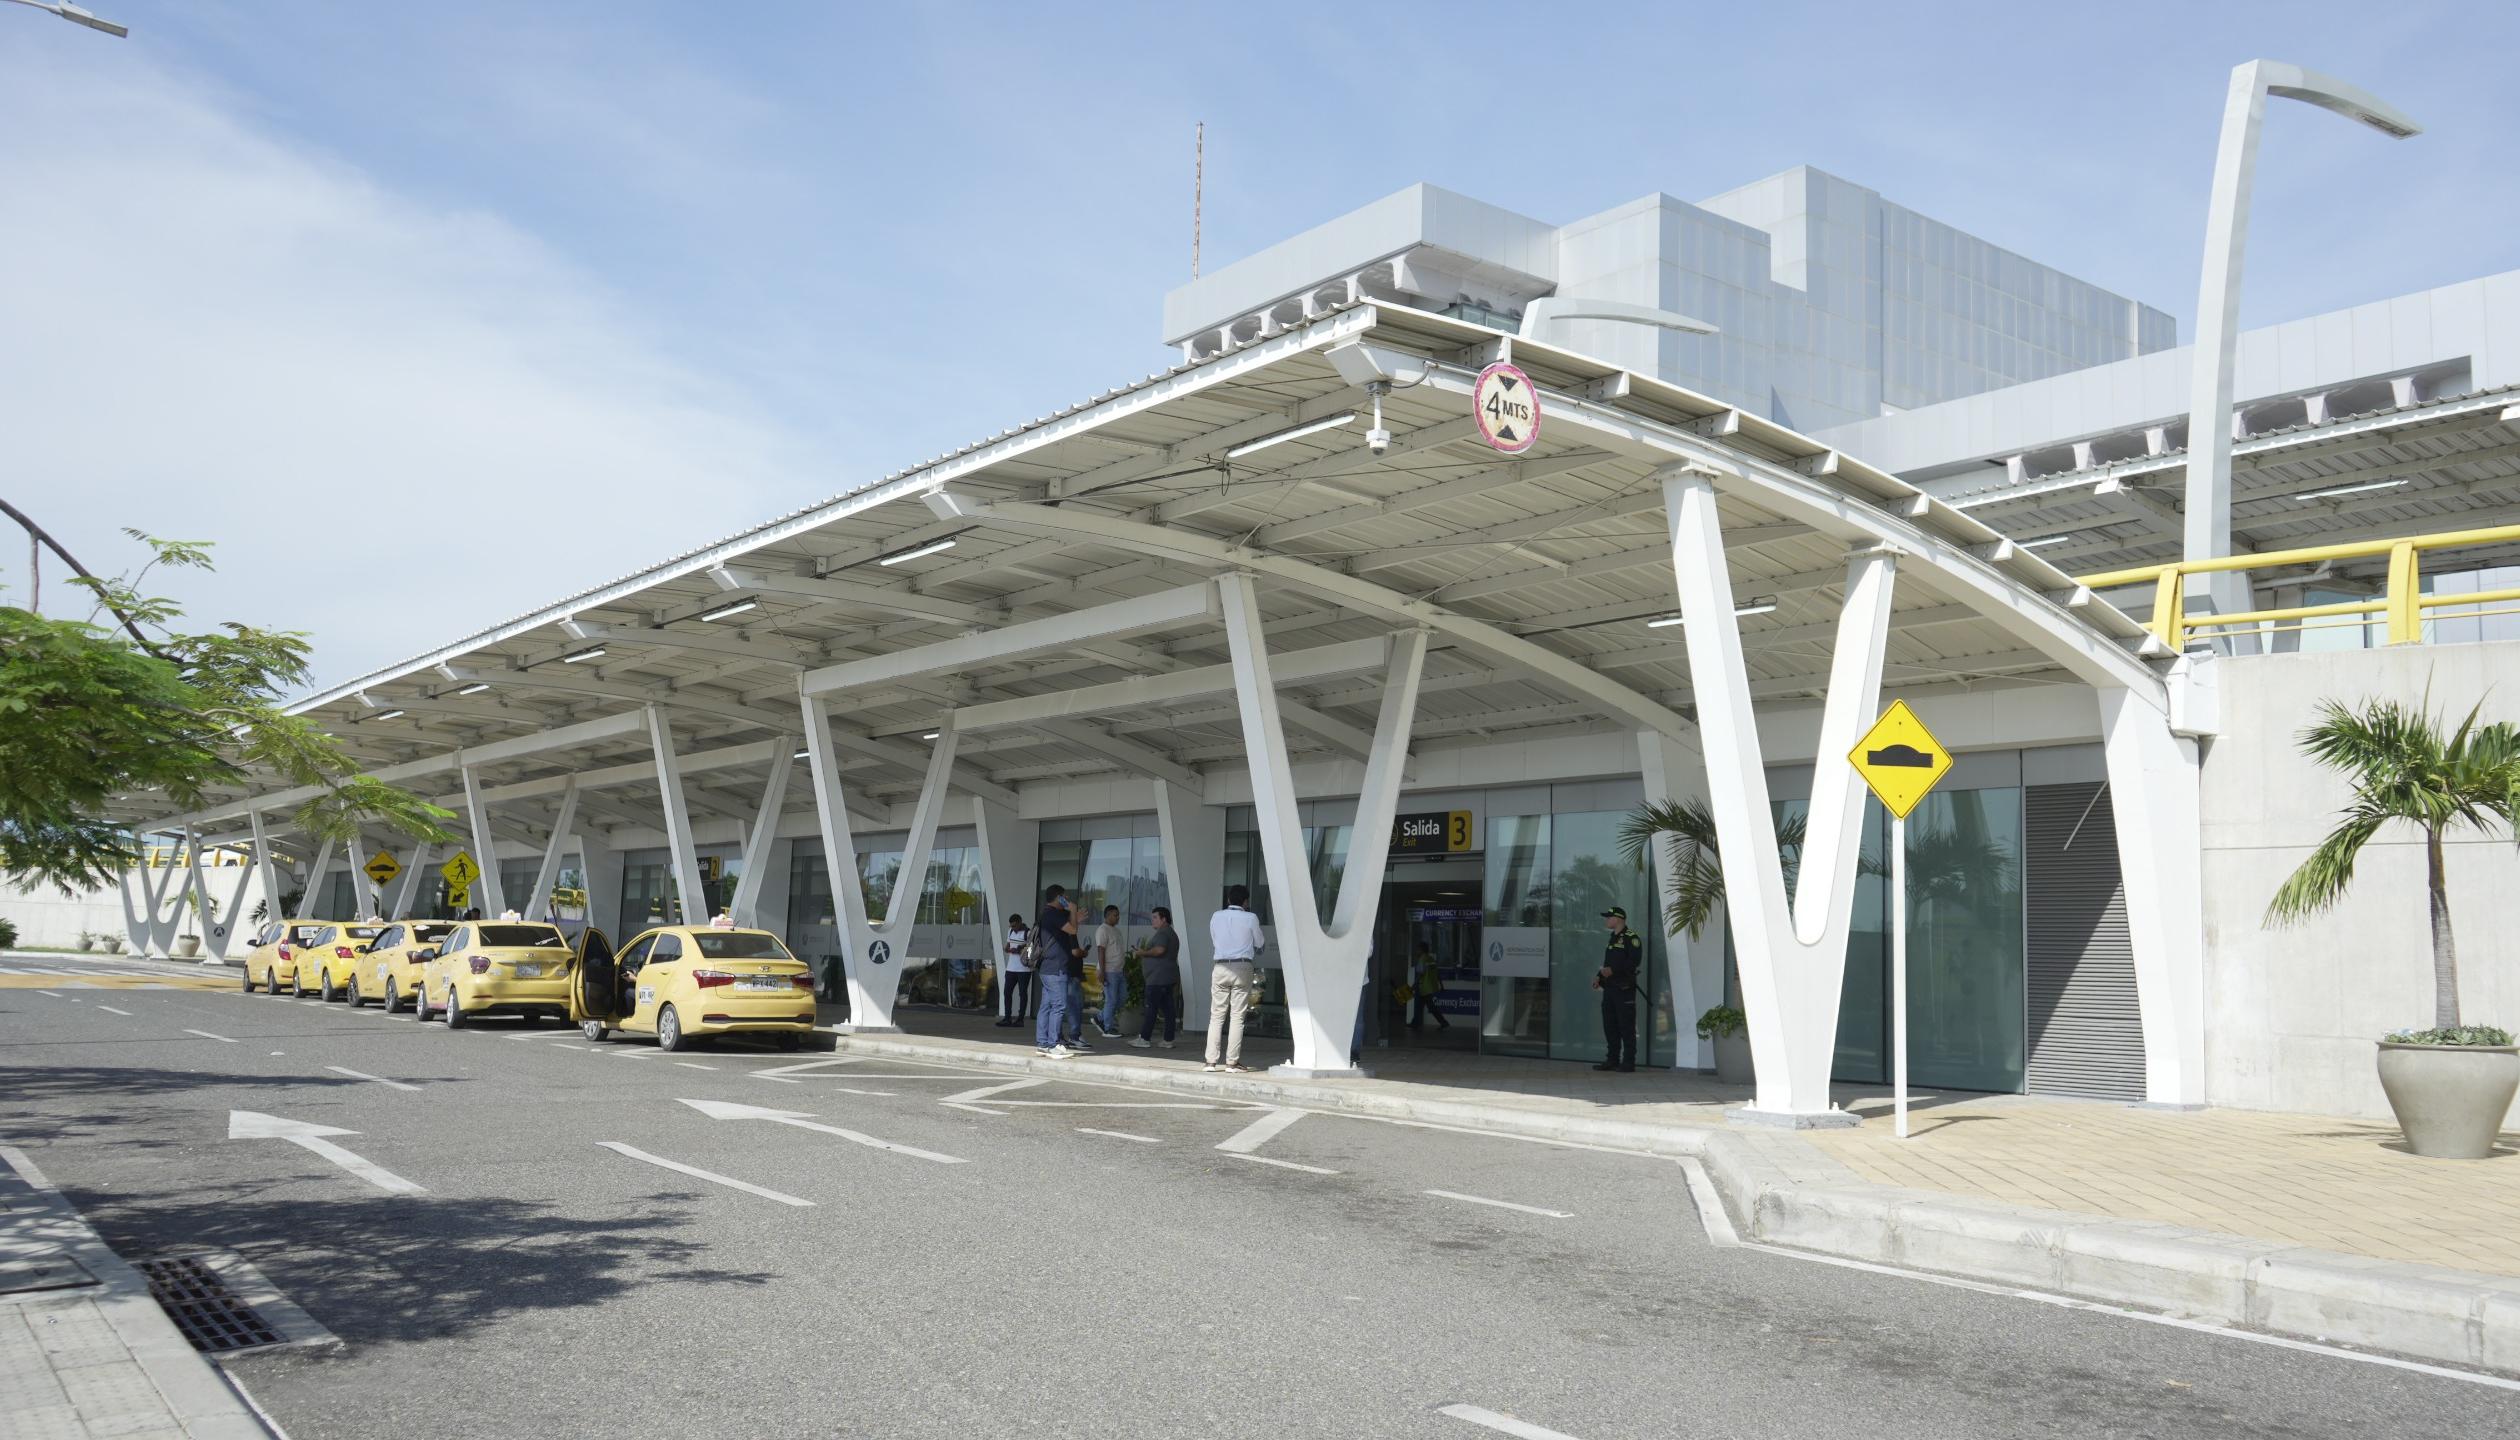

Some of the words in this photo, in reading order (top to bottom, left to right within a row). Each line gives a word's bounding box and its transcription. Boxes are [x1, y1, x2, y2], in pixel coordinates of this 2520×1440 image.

[1486, 392, 1500, 420] 4
[1502, 400, 1528, 420] MTS
[1403, 819, 1440, 836] Salida
[1453, 816, 1466, 846] 3
[1402, 837, 1417, 847] Exit
[712, 860, 718, 877] 2
[1425, 909, 1456, 917] CURRENCY
